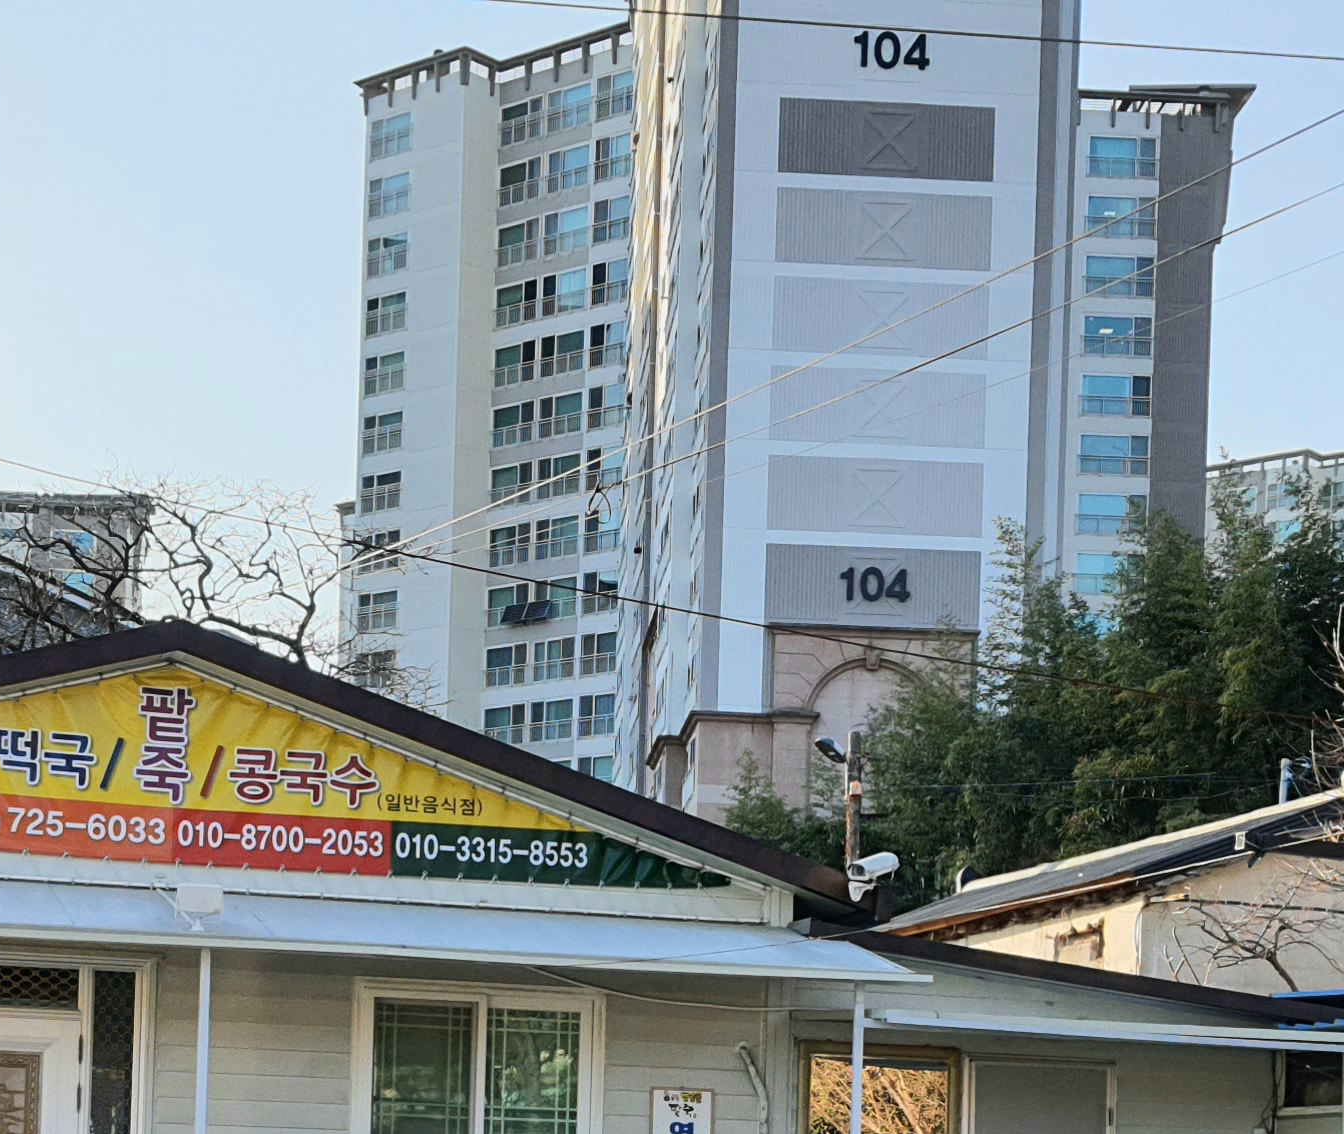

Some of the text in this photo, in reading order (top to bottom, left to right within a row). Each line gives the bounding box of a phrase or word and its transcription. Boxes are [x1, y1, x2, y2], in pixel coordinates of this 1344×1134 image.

[854, 30, 930, 70] 104
[840, 566, 911, 603] 104
[228, 747, 380, 809] 콩국수
[377, 793, 483, 817] (일반음식점)
[7, 807, 166, 844] 725-6033
[177, 821, 384, 858] 010-8700-2053
[395, 833, 588, 868] 010-3315-8553
